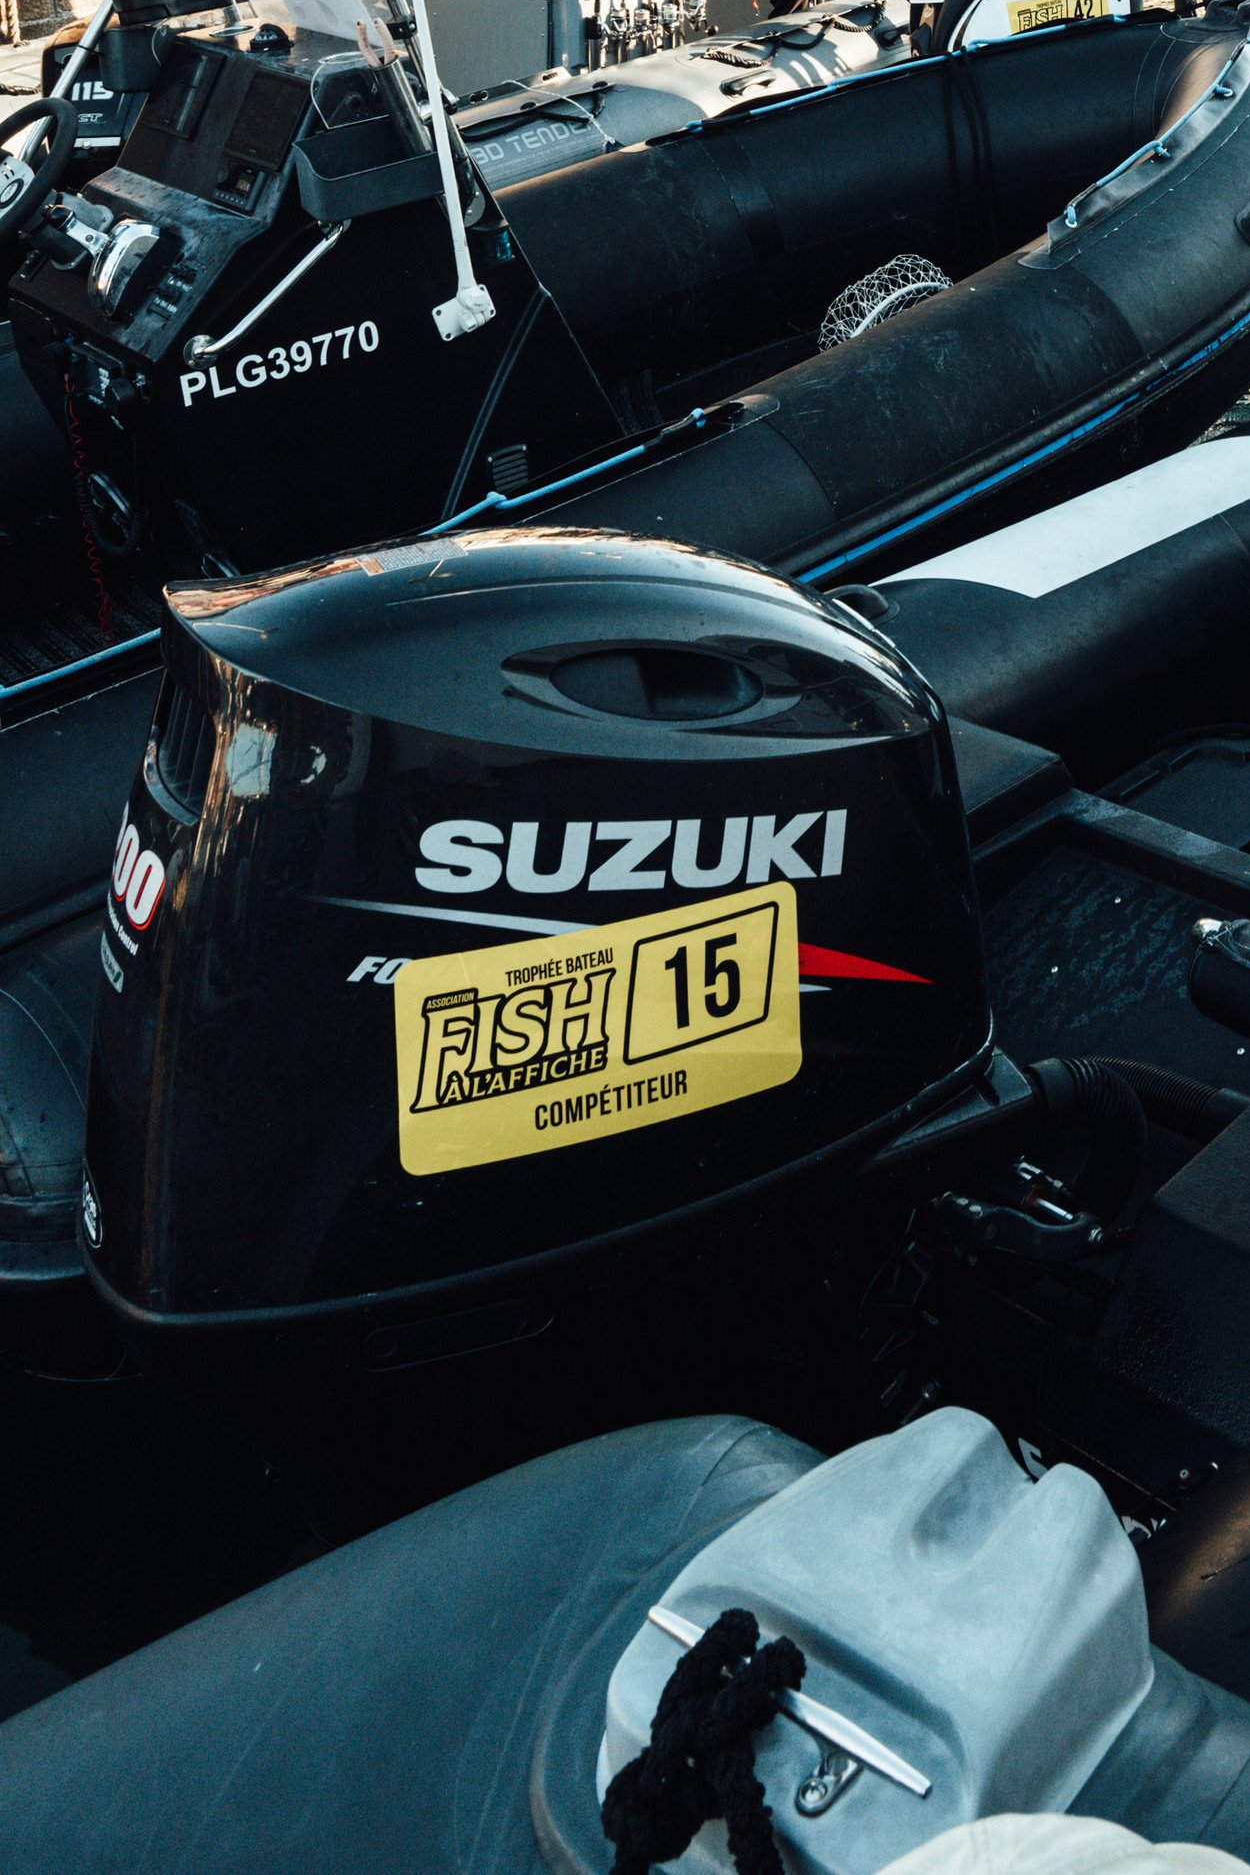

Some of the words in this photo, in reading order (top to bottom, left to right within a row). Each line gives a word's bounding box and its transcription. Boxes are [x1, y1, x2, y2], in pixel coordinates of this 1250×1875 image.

[1018, 4, 1063, 32] FISH
[71, 81, 114, 101] 115
[505, 121, 592, 153] TENDE
[179, 320, 380, 407] PLG39770
[415, 808, 847, 893] SUZUKI
[505, 959, 563, 987] TROPHÉE
[566, 947, 614, 974] BATEAU
[664, 933, 741, 1029] 15
[426, 992, 475, 1010] ASSOCIATION
[409, 967, 617, 1114] FISH
[470, 1045, 607, 1099] L'AFFICHE
[535, 1070, 688, 1131] COMPÉTITEUR
